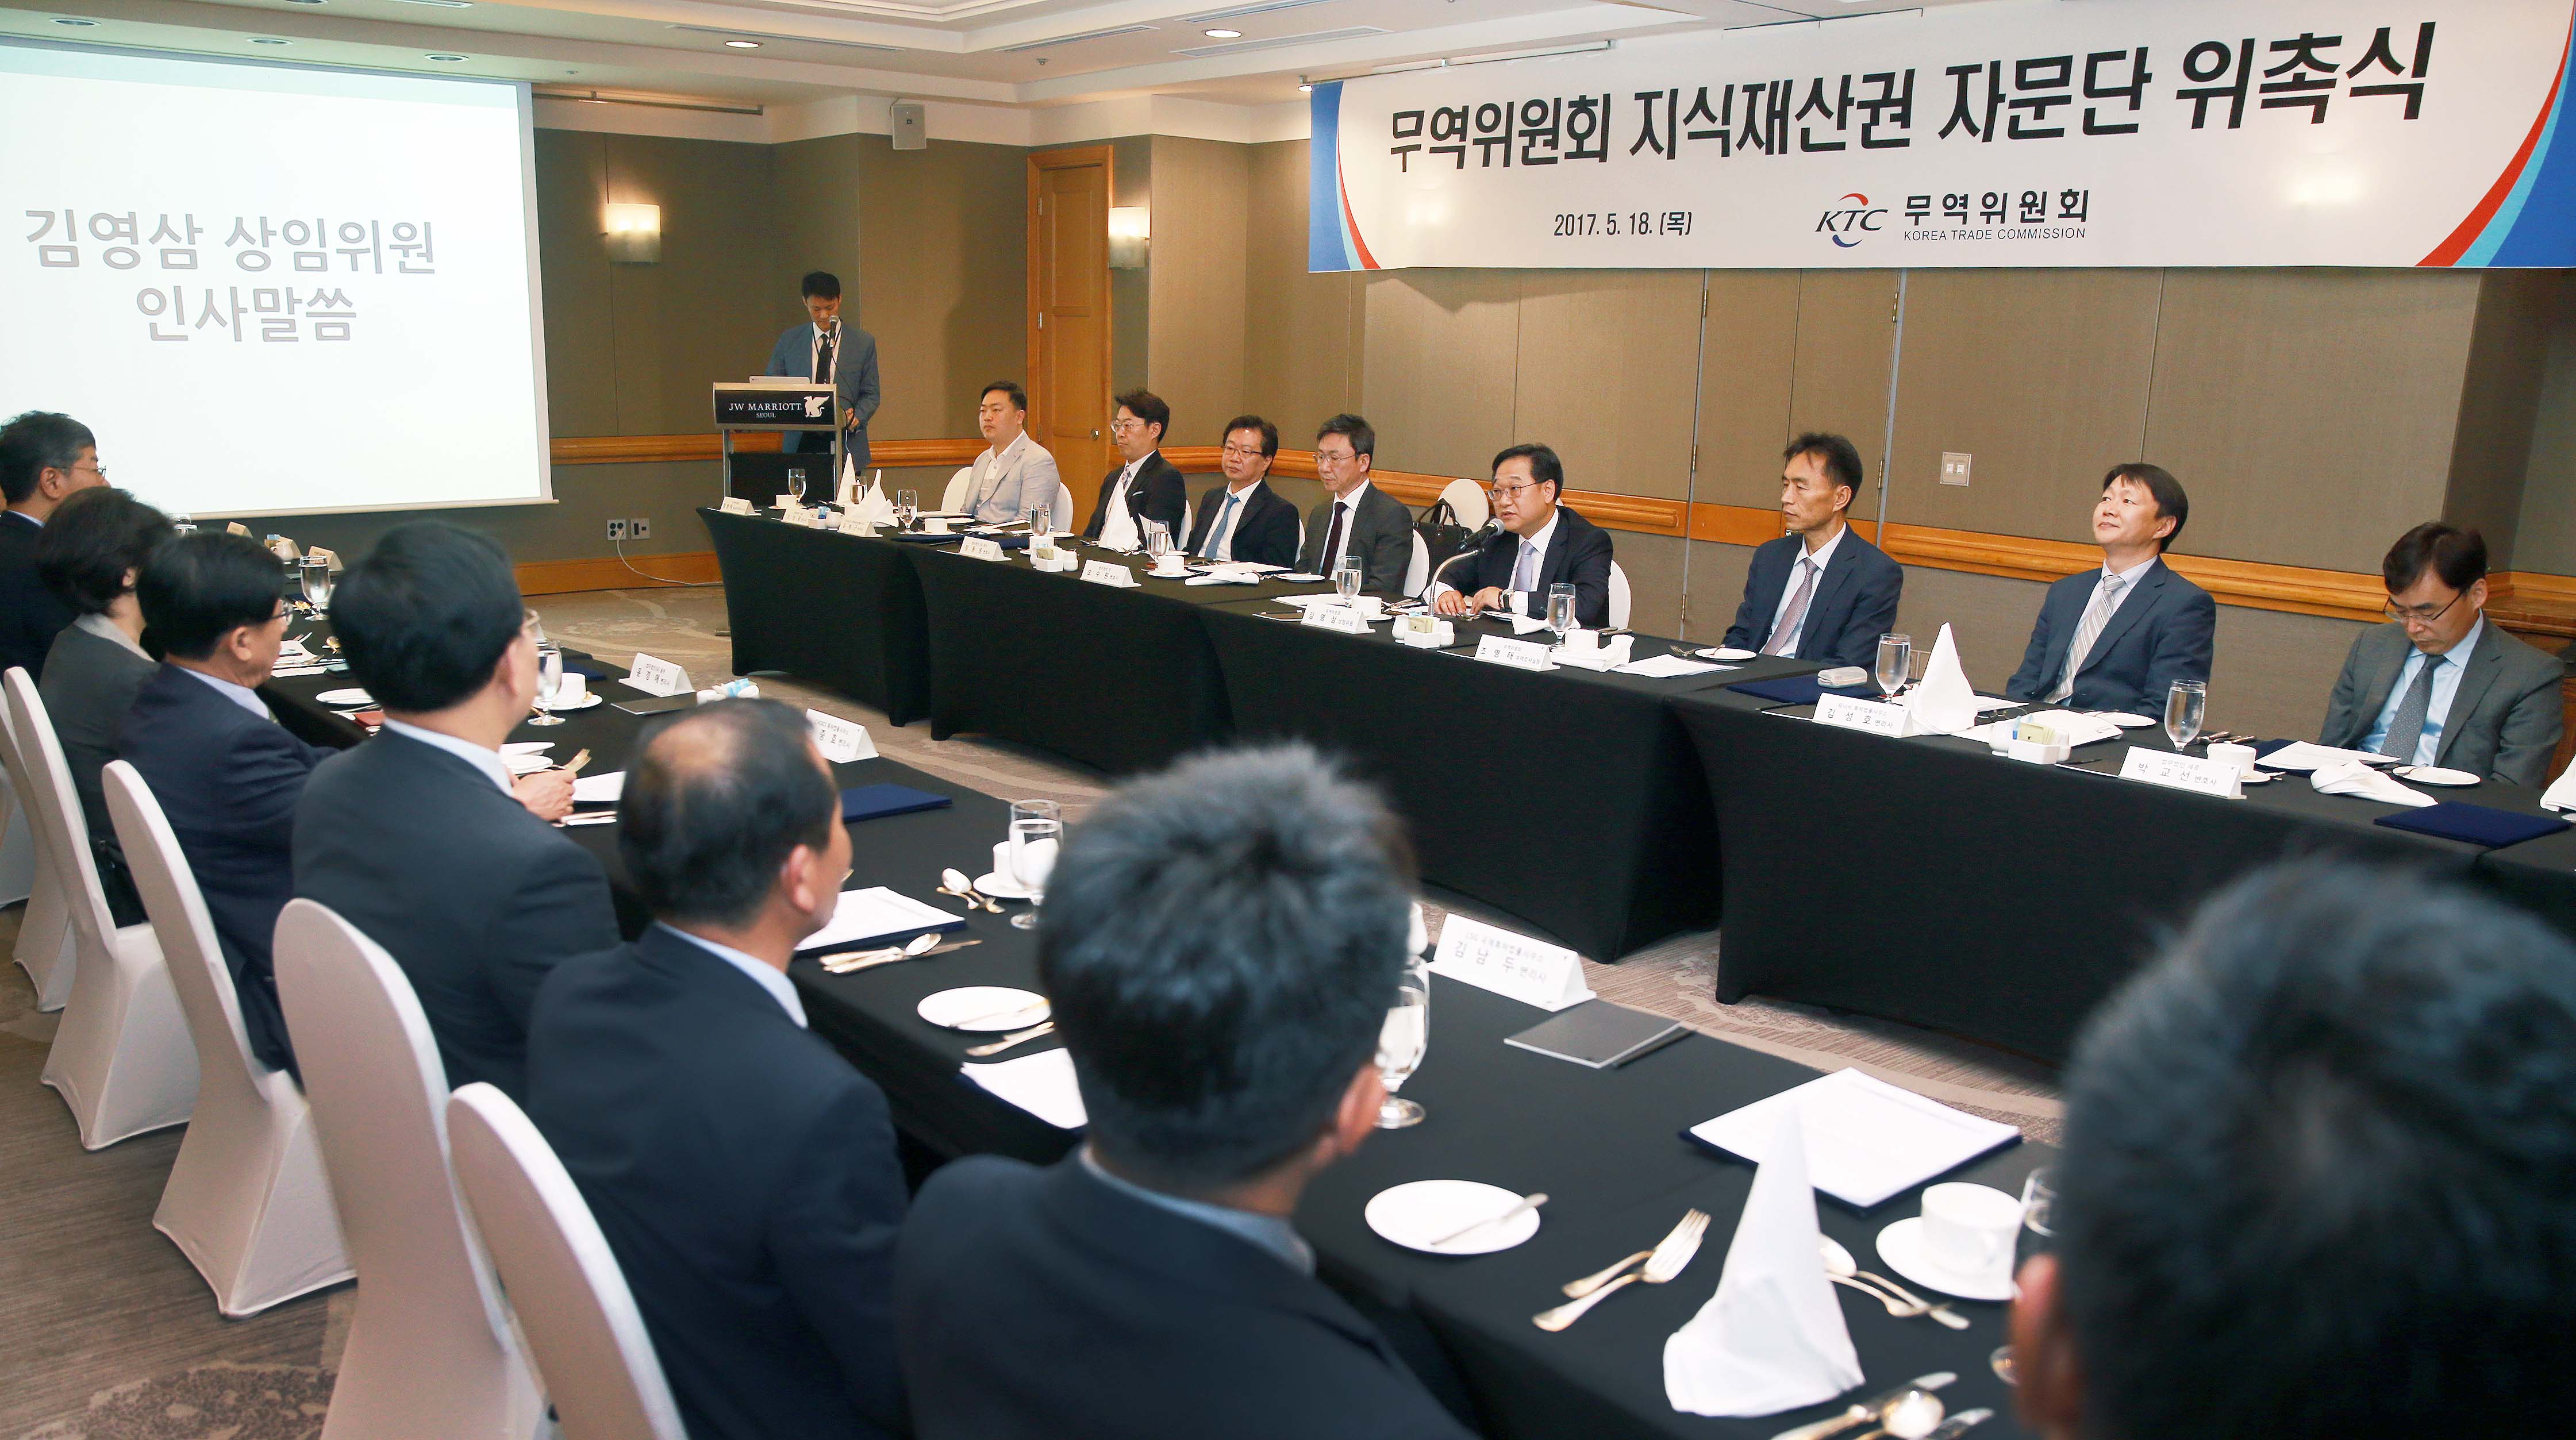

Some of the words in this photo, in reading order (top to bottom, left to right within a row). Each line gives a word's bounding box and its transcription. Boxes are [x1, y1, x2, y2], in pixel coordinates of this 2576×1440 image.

[1391, 94, 1610, 172] 무역위원회
[1629, 69, 1915, 160] 지식재산권
[1938, 47, 2152, 143] 자문단
[2176, 22, 2435, 129] 위촉식
[1904, 188, 2089, 226] 무역위원회
[1554, 213, 1600, 236] 2017.
[1606, 213, 1620, 236] 5.
[1629, 211, 1652, 236] 18.
[1814, 209, 1889, 232] KTC
[25, 209, 204, 270] 김영삼
[224, 215, 436, 275] 상임위원
[1904, 230, 1947, 241] KOREA
[1951, 229, 1992, 240] TRADE
[1997, 228, 2086, 240] COMMISSION
[136, 285, 357, 342] 인사말씀
[729, 403, 744, 411] JW
[748, 403, 802, 411] MARRIOTT
[1827, 708, 1871, 725] 김성호
